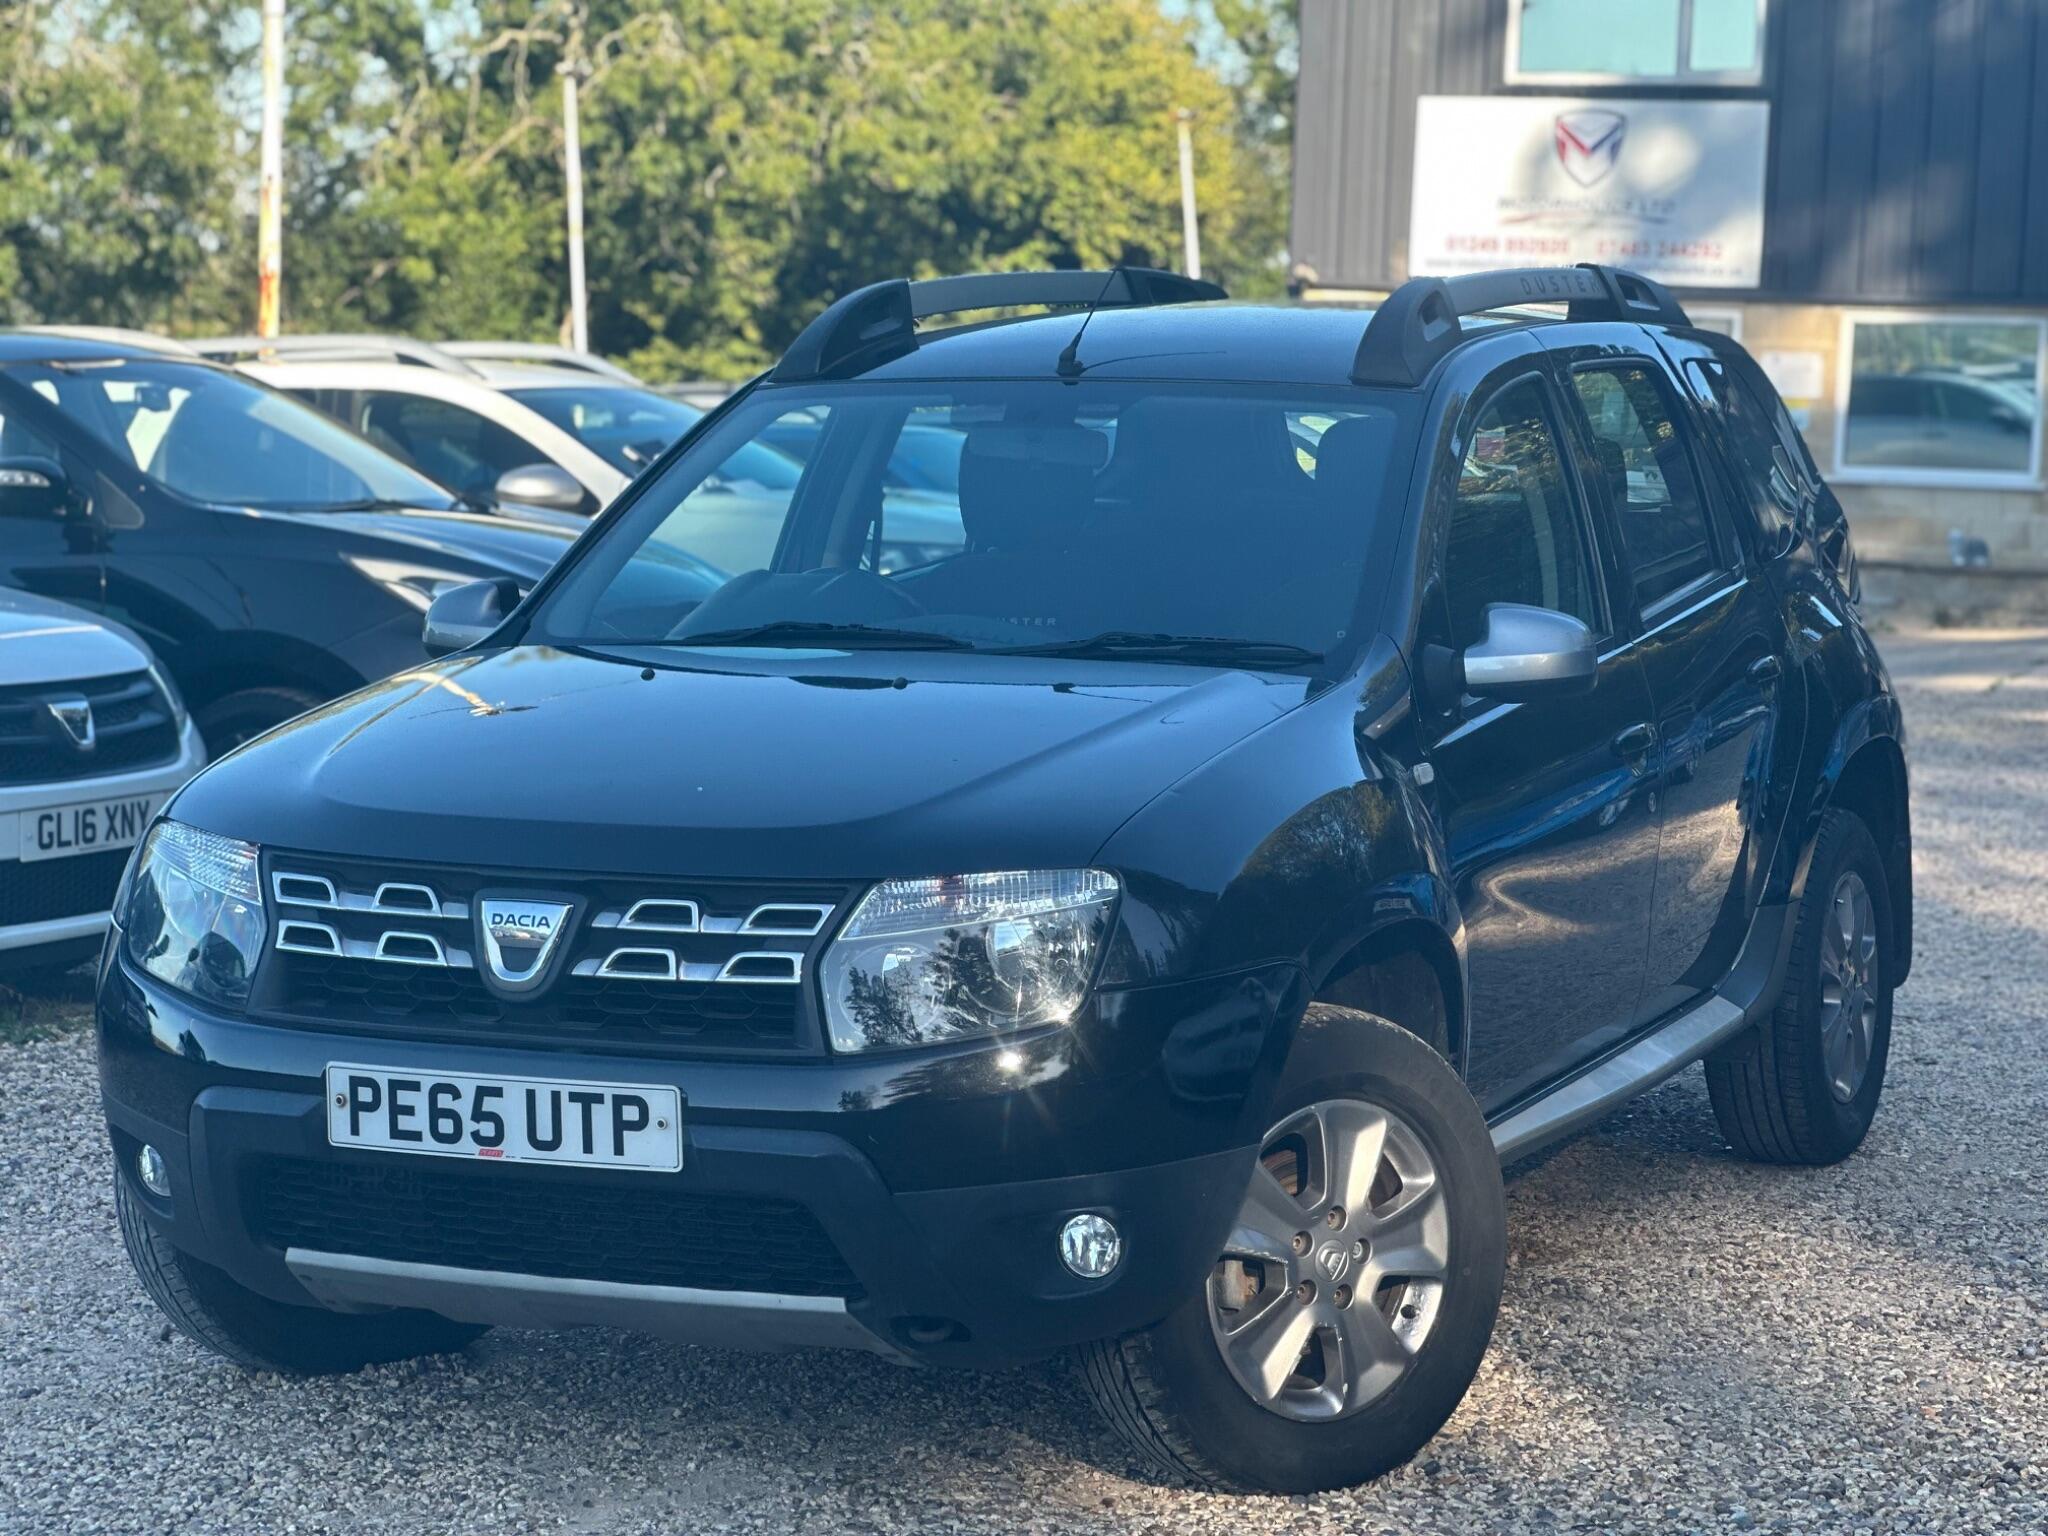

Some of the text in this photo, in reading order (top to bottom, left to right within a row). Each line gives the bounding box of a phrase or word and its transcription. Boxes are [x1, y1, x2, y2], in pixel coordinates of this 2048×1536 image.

[37, 800, 150, 850] GL16 XNY
[491, 912, 551, 929] DACIA
[348, 1074, 650, 1156] PE65 UTP
